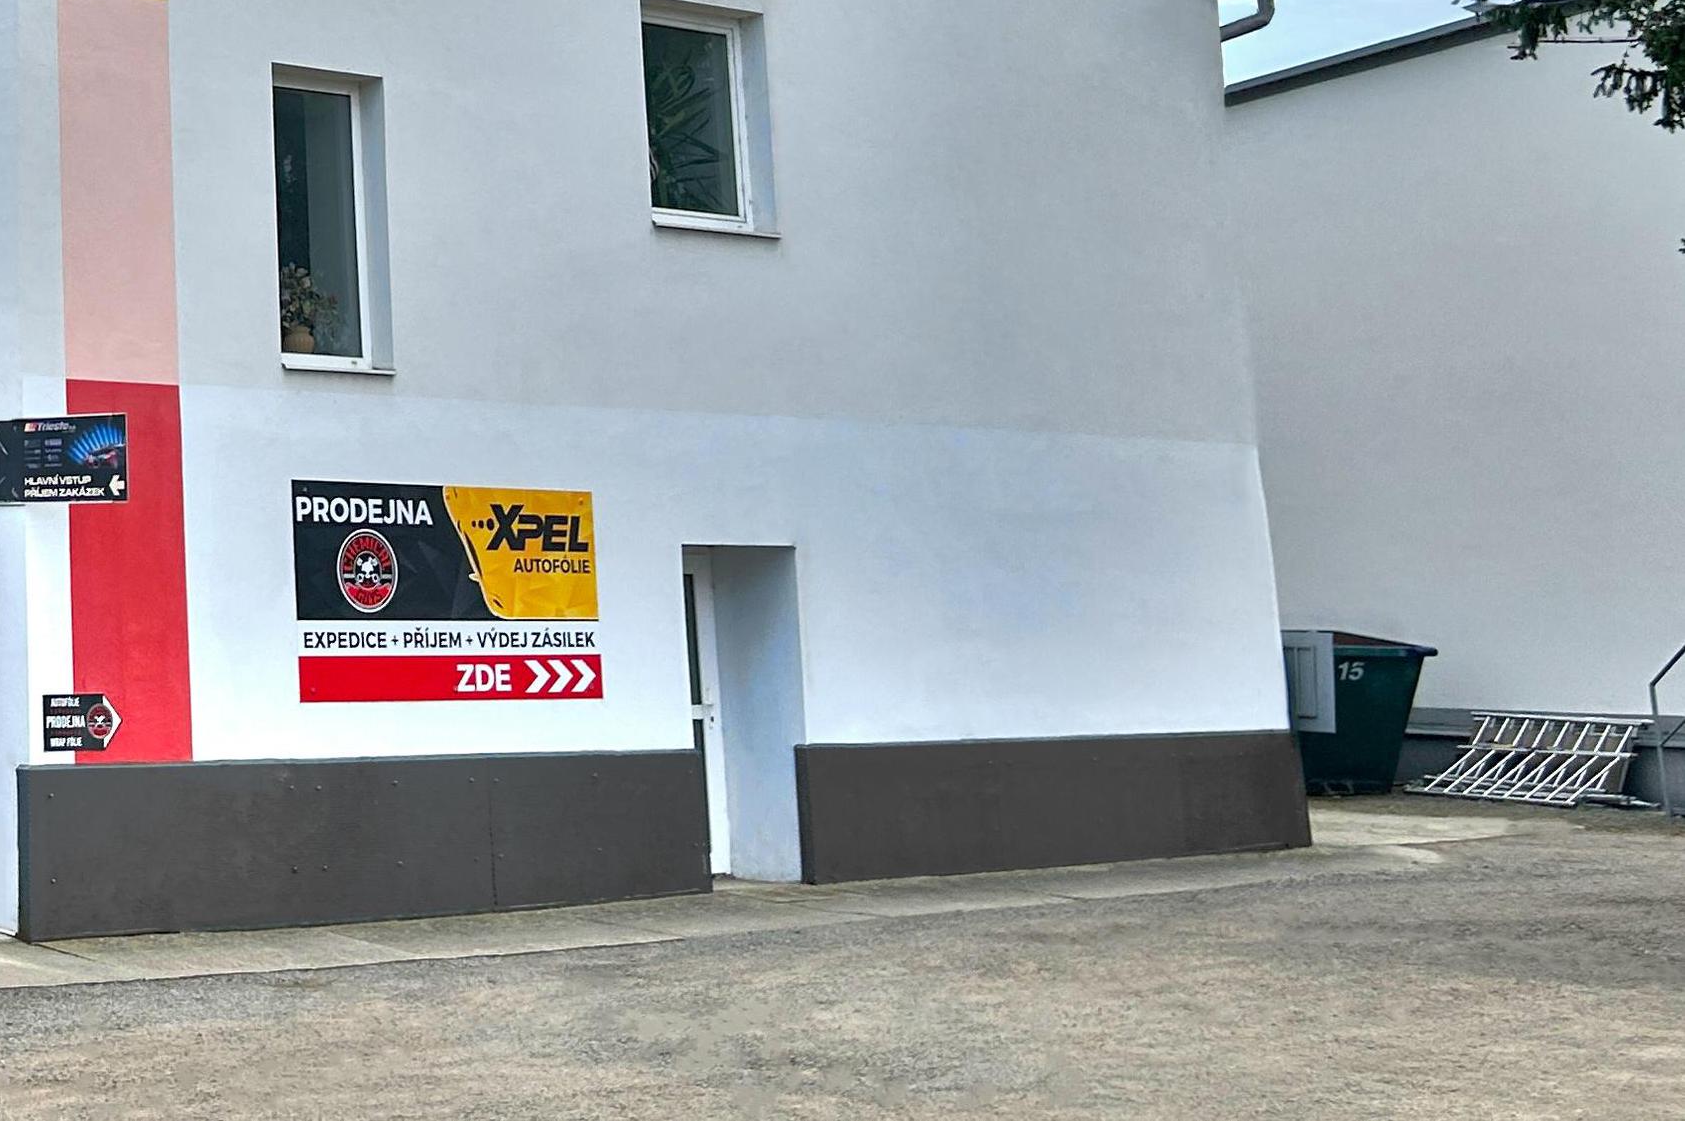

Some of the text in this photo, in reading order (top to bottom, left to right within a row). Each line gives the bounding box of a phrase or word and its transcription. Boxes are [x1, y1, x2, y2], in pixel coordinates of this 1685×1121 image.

[24, 474, 92, 486] HLAVNÍ VSTUP
[295, 496, 434, 526] PRODEJNA
[486, 503, 589, 553] XPEL
[513, 554, 592, 574] AUTOFÓLIE
[303, 631, 388, 649] EXPEDICE
[403, 627, 462, 649] PŘÍJEM
[477, 627, 527, 649] VÝDEJ
[531, 627, 596, 648] ZÁSILEK
[456, 663, 512, 692] ZDE
[1338, 661, 1365, 680] 15
[46, 715, 86, 729] PRODEJNA
